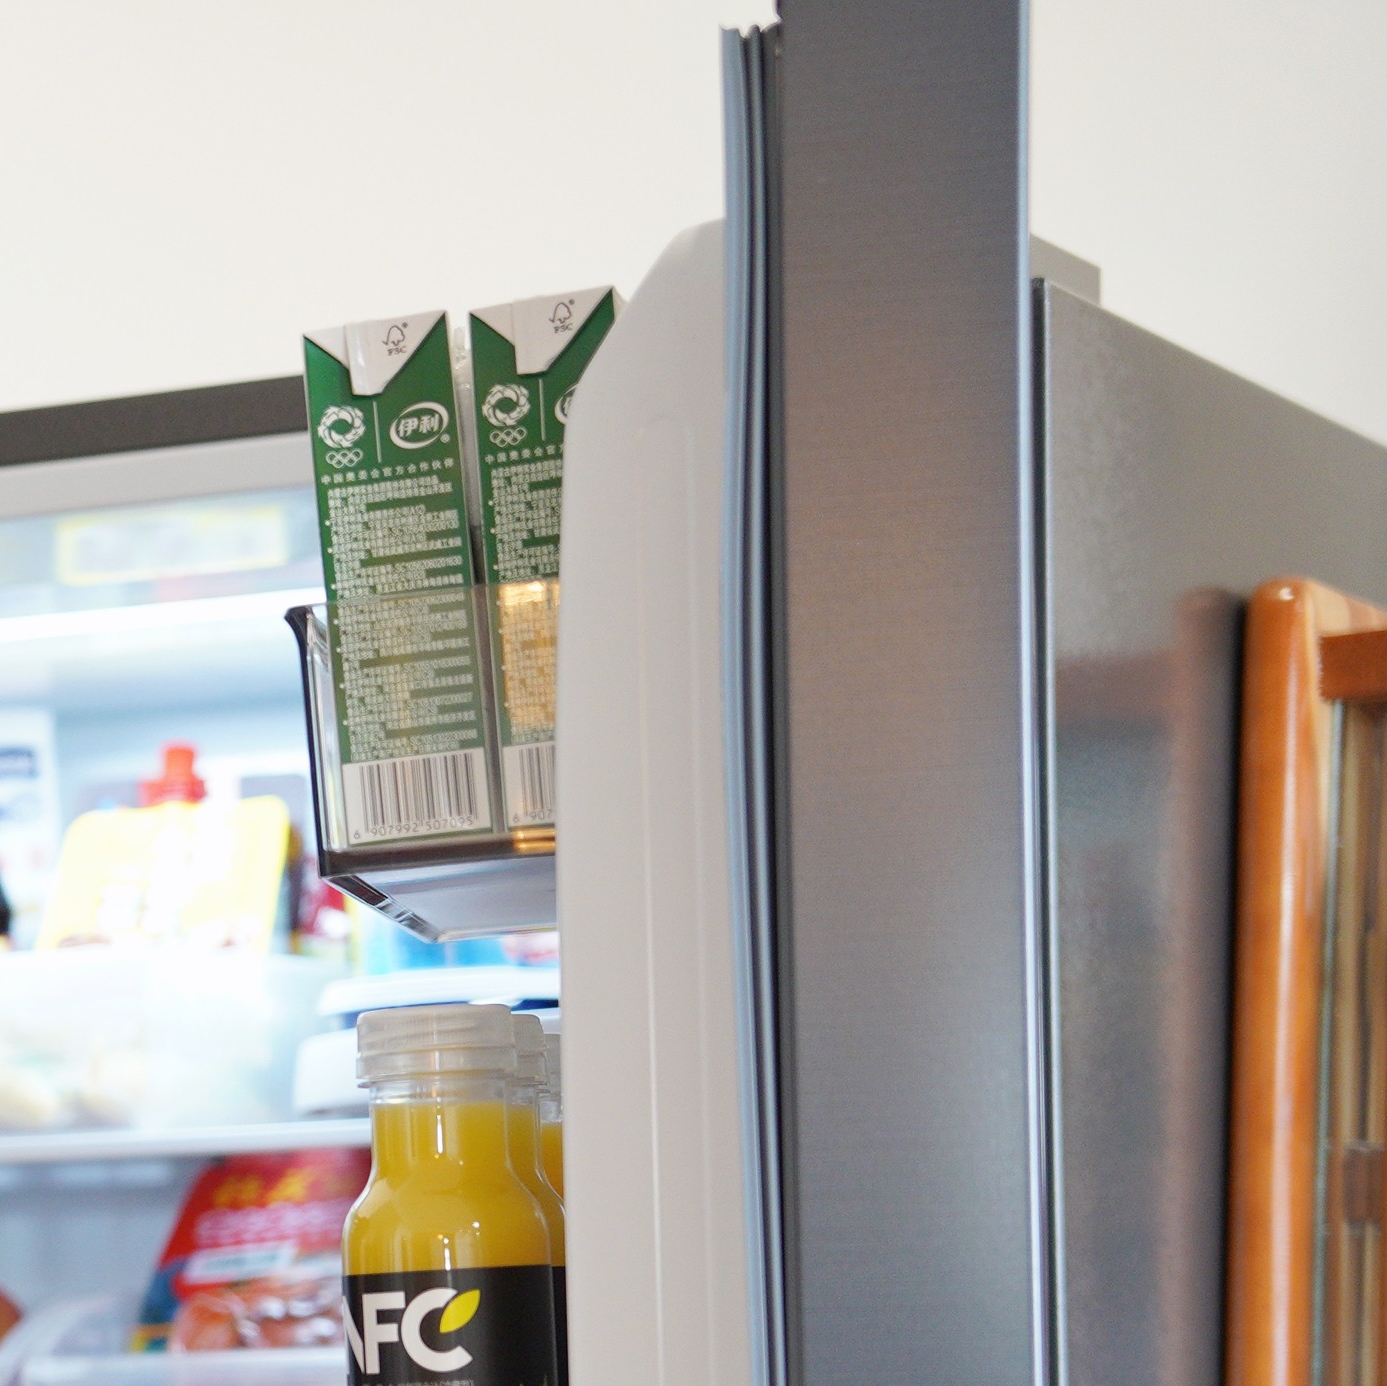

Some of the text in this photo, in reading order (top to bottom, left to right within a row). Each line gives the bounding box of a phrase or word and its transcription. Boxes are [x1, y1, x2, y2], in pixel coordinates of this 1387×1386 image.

[387, 345, 407, 356] FSC
[397, 412, 440, 438] 伊利
[353, 814, 474, 841] 6 907992 507095
[512, 813, 521, 824] 6
